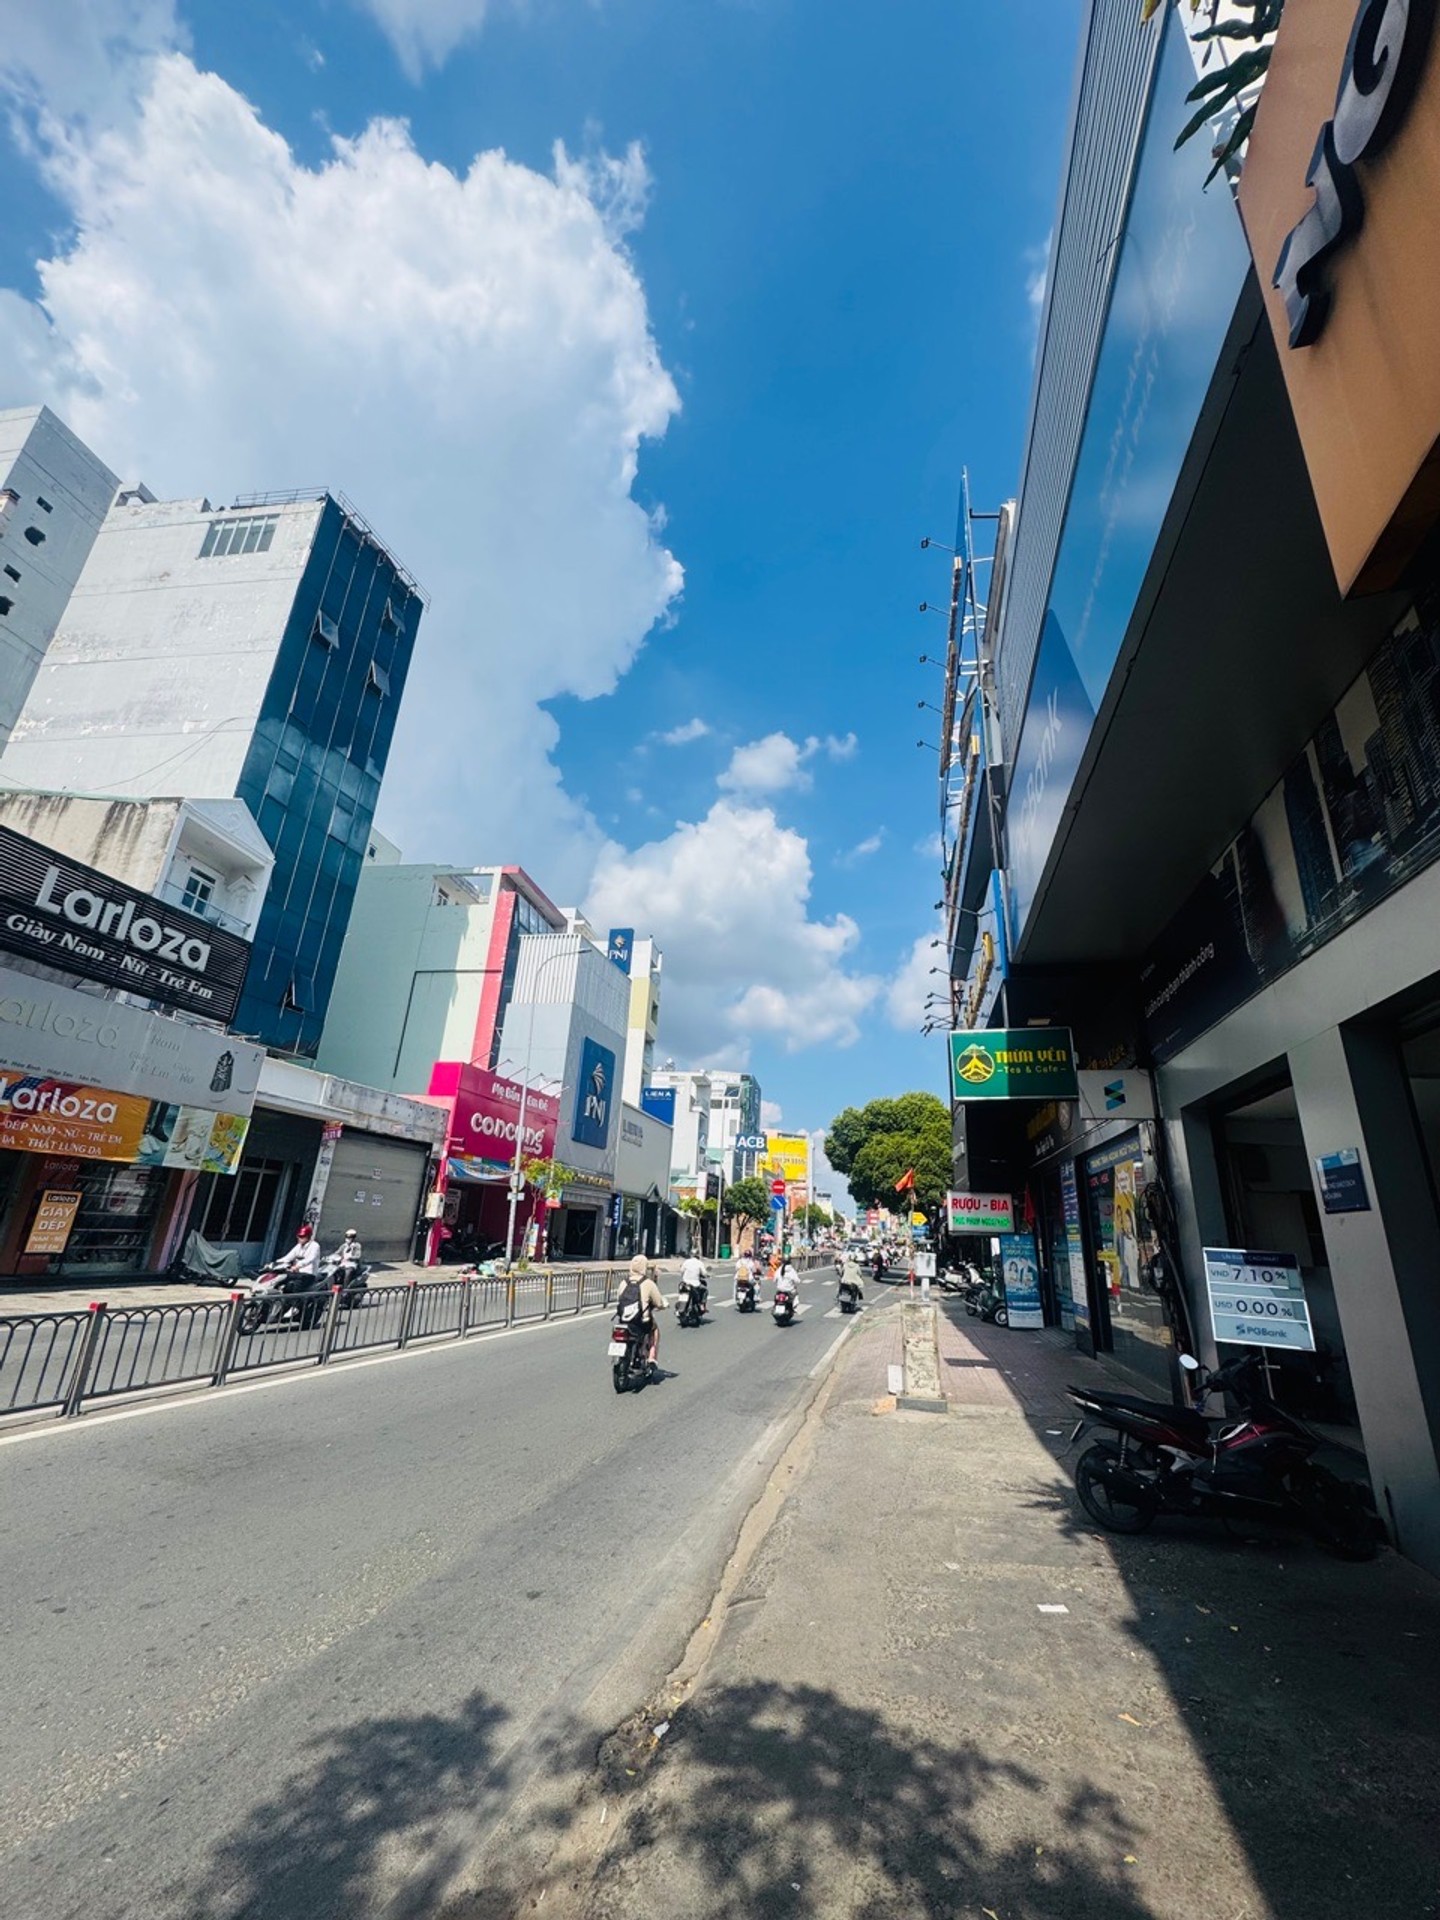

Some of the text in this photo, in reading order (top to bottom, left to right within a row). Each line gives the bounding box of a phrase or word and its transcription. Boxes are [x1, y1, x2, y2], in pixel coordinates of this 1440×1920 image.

[35, 865, 211, 972] Larloza
[6, 914, 57, 945] Giày
[61, 933, 105, 961] Nam
[120, 955, 150, 976] Nữ
[157, 967, 185, 989] Trẻ
[188, 981, 213, 999] Em
[608, 950, 628, 961] PNJ
[0, 1077, 118, 1124] Larloza
[584, 1096, 606, 1128] PNJ
[31, 1123, 56, 1136] NAM
[737, 1135, 765, 1148] ACB
[951, 1197, 981, 1213] RƯỢU
[990, 1199, 1009, 1211] BIA
[1211, 1269, 1229, 1277] VND
[1215, 1301, 1232, 1309] USD
[1246, 1326, 1287, 1337] PGBank
